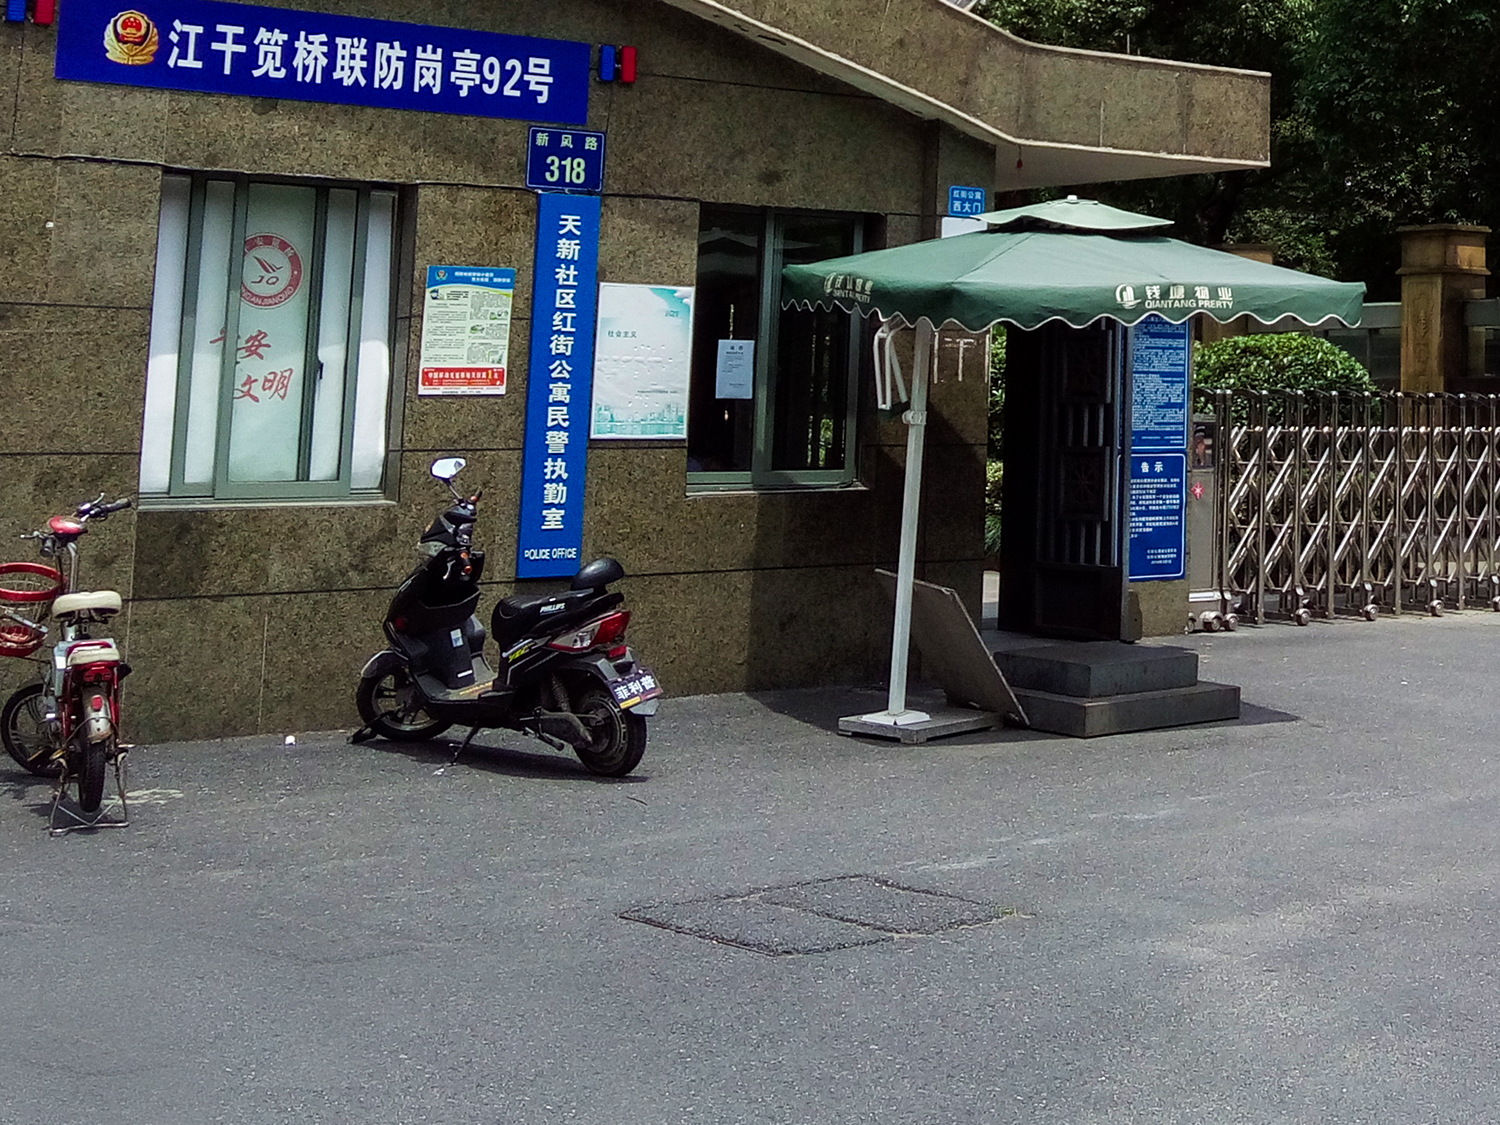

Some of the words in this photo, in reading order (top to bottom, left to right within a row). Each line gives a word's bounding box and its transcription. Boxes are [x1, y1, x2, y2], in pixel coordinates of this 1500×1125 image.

[167, 18, 555, 105] 江干笕桥联防岗亭92号
[535, 132, 598, 151] 新风路
[545, 155, 586, 184] 318
[953, 201, 981, 213] 西大门
[1145, 299, 1197, 309] QIANTANG
[1198, 299, 1234, 309] PRERTY
[607, 330, 637, 339] 社会主义
[540, 214, 582, 531] 天新社区红街公寓民警执勤室
[232, 367, 293, 404] 文明
[1141, 461, 1164, 473] 告示
[525, 548, 550, 560] POLICE
[551, 547, 577, 559] OFFICE
[614, 675, 656, 700] 菲利普
